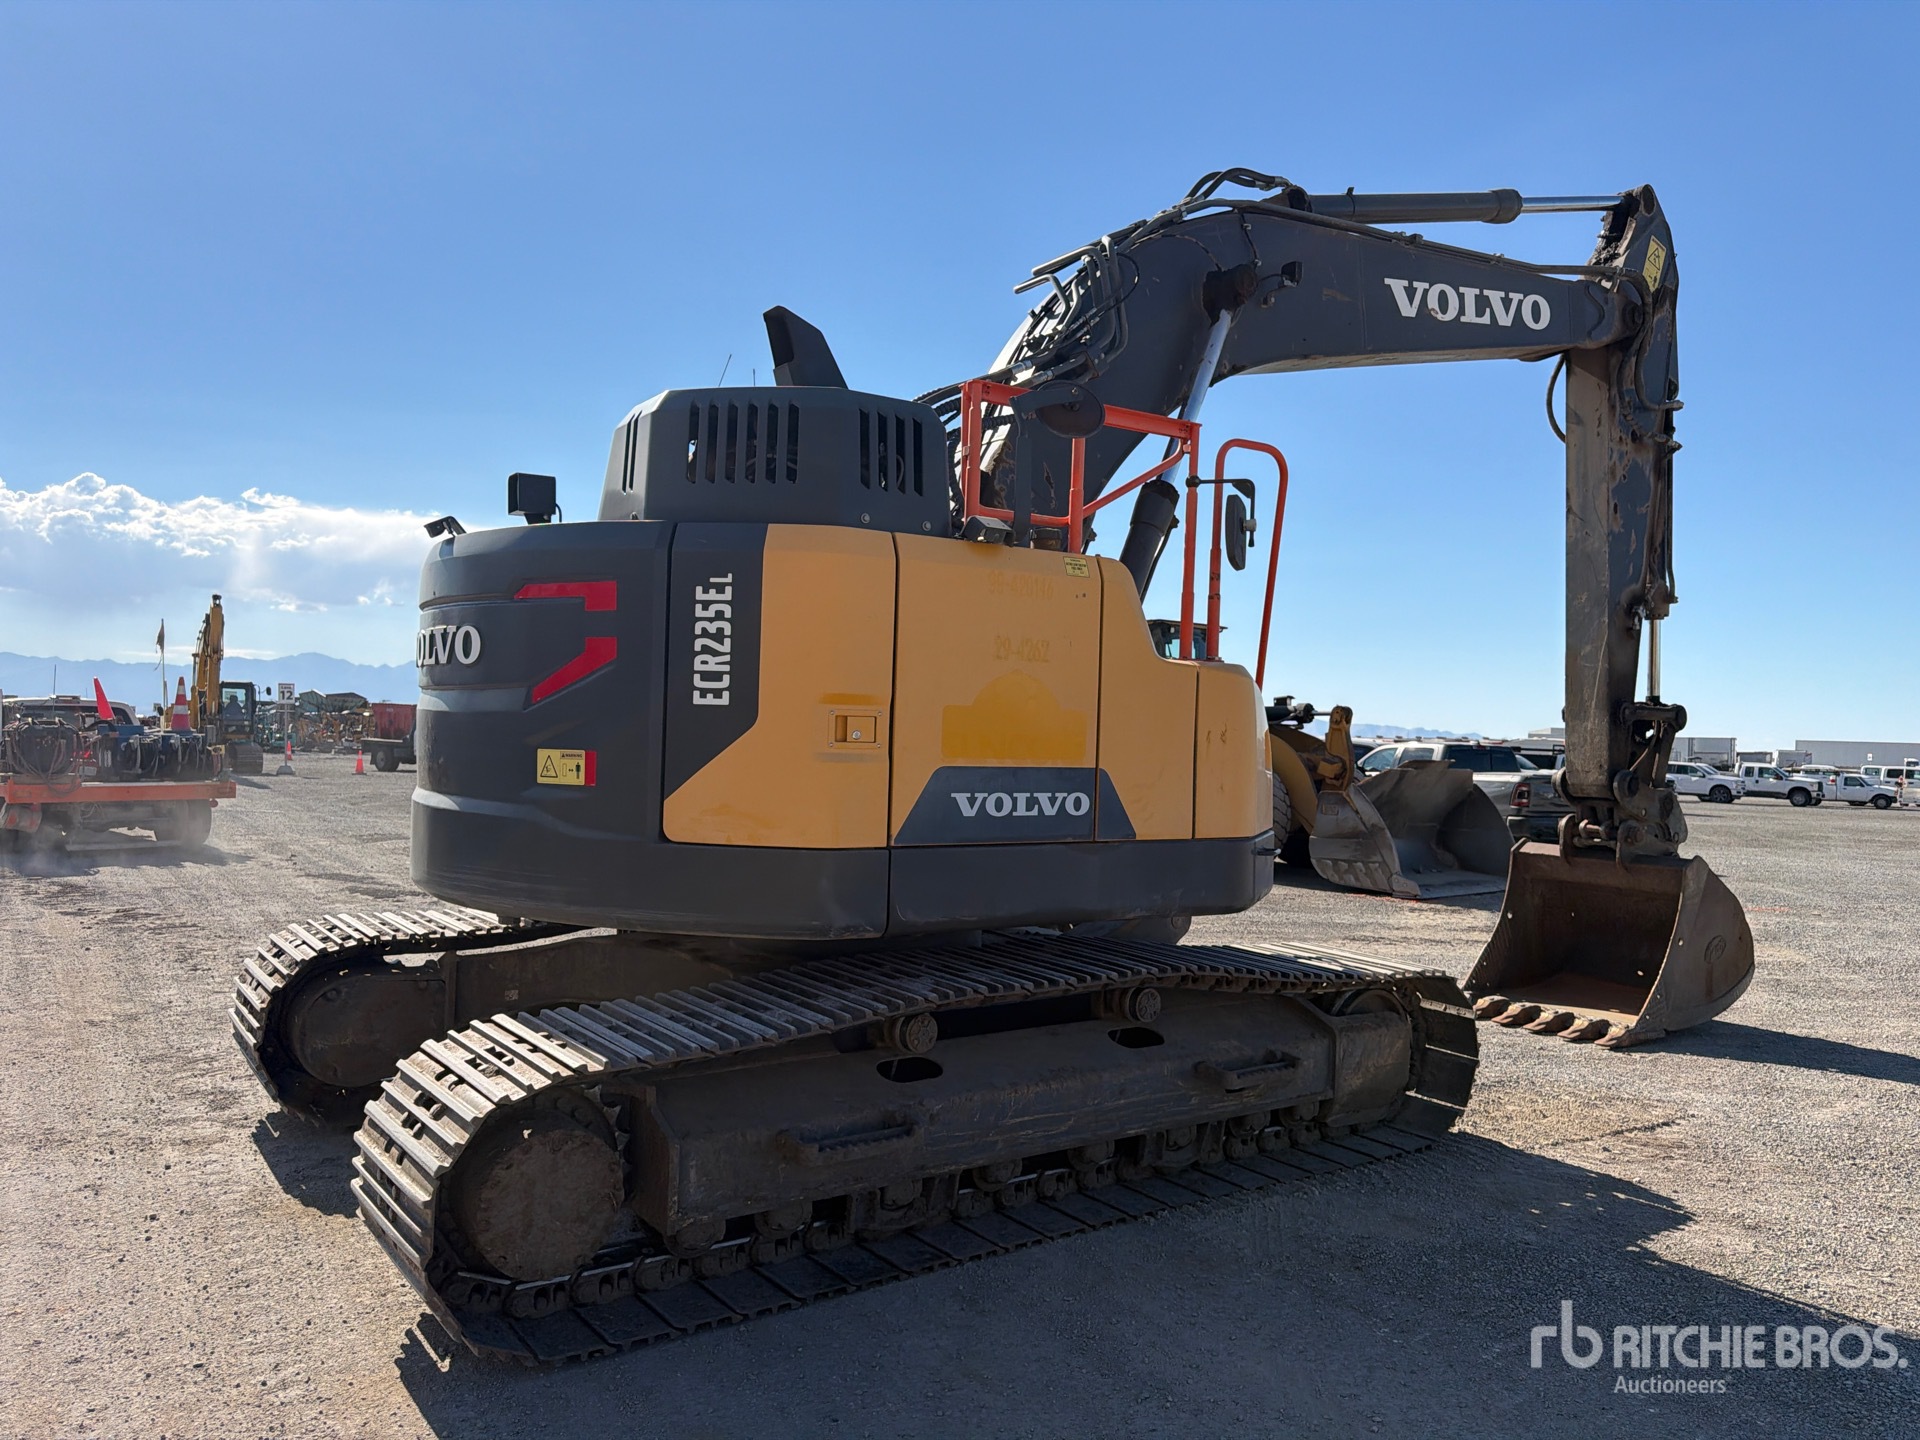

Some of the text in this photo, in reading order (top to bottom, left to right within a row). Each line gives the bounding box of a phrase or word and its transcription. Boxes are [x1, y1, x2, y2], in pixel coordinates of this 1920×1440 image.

[1384, 277, 1551, 331] VOLVO
[417, 625, 481, 667] OLVO
[280, 690, 293, 701] 12
[951, 792, 1090, 817] VOLVO
